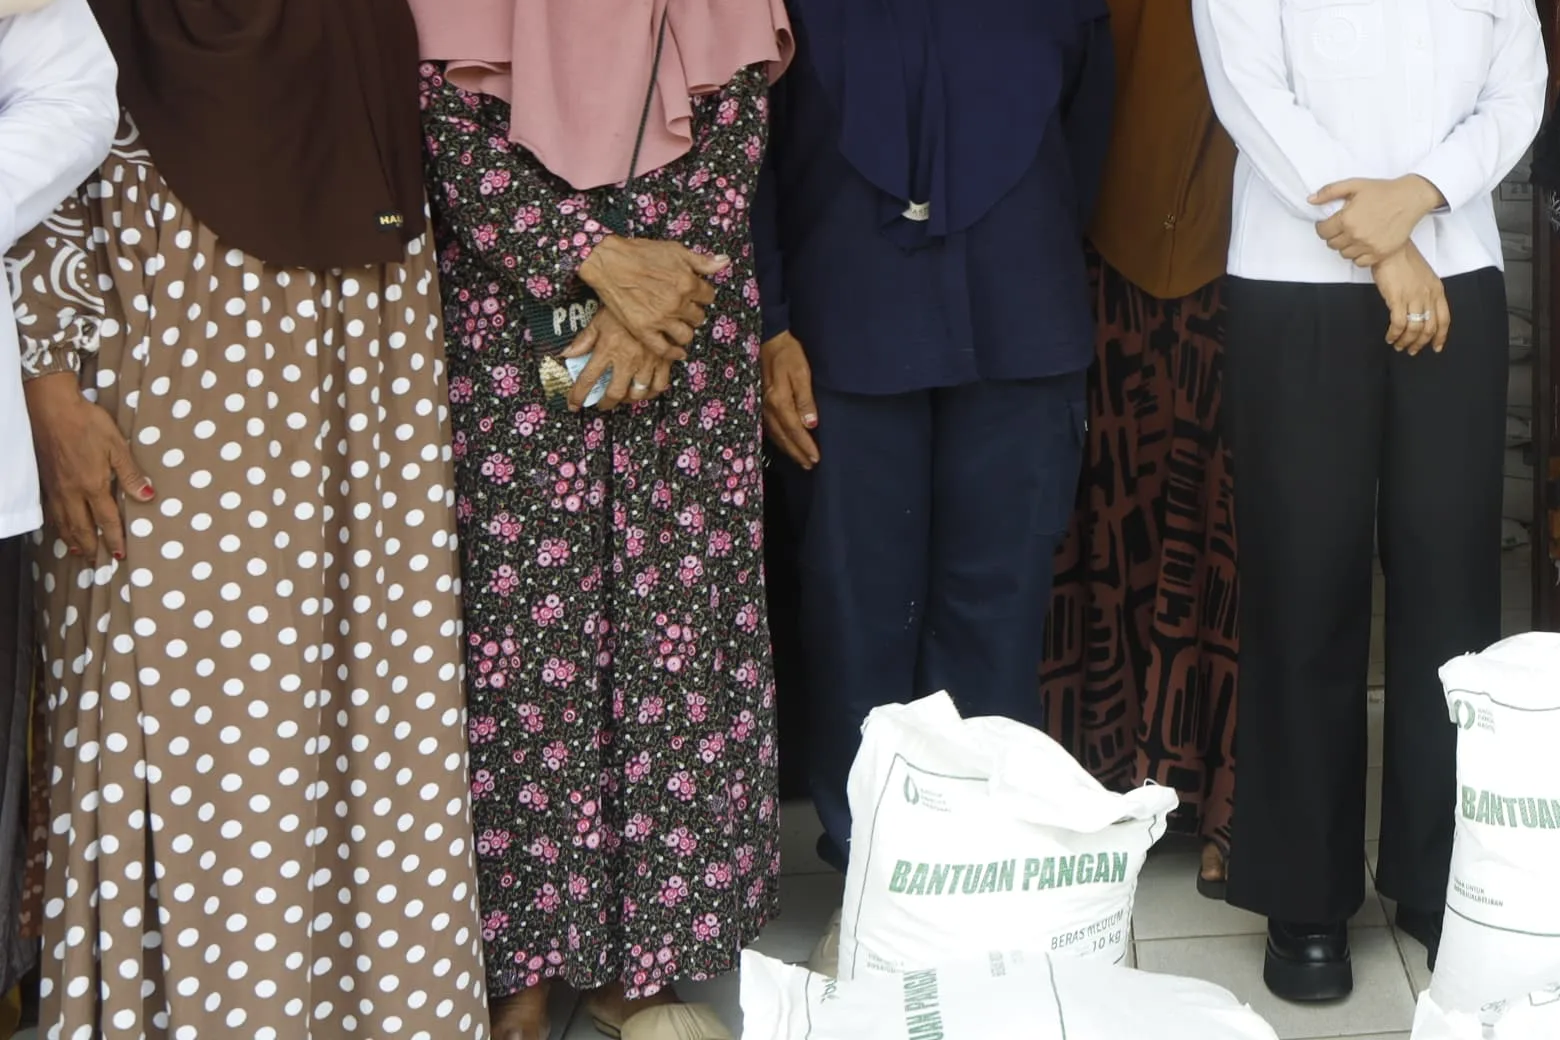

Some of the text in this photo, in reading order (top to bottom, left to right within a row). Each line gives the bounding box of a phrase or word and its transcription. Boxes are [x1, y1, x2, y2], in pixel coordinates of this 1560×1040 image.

[888, 851, 1129, 896] BANTUAN PANGAN
[1050, 908, 1125, 950] BERAS MEDIUM
[1092, 929, 1122, 952] 10 kg
